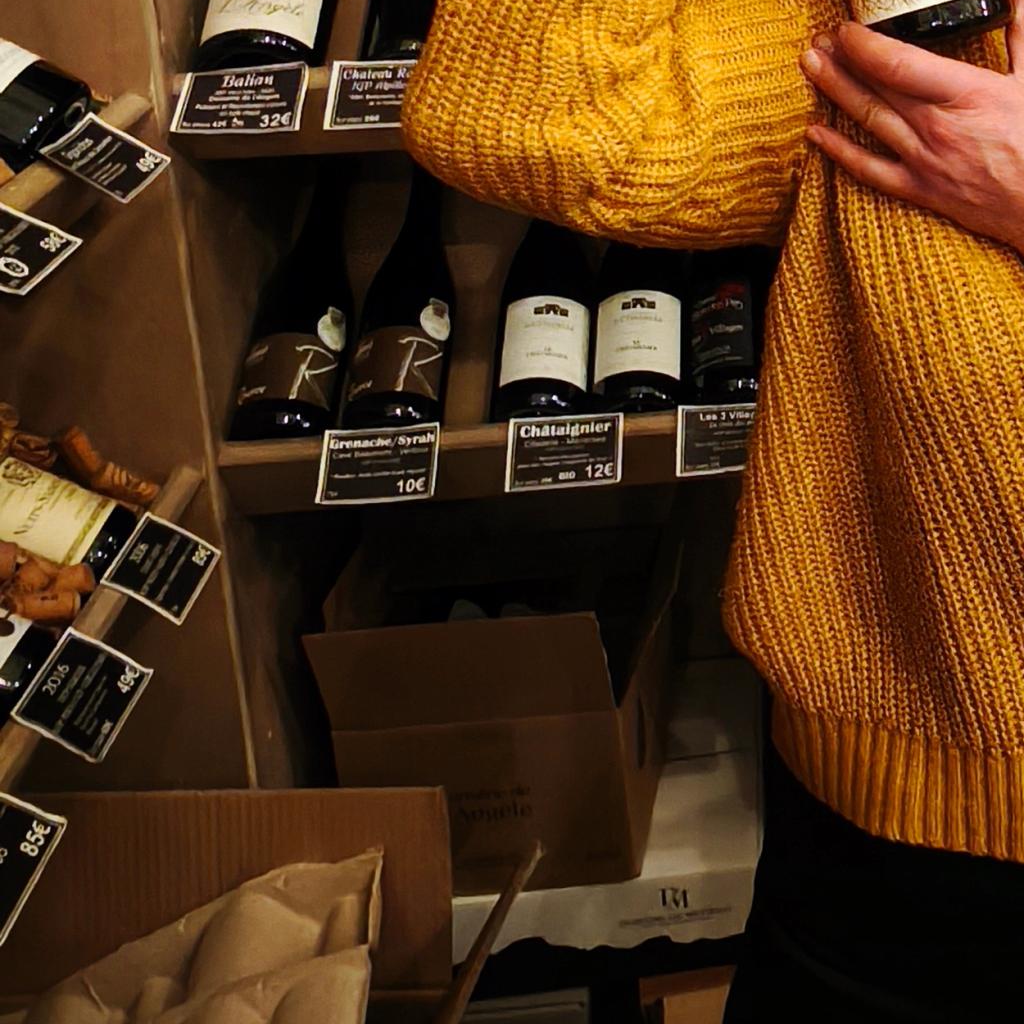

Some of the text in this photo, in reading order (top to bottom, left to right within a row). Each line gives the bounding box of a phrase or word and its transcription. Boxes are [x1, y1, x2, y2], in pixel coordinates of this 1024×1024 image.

[258, 112, 293, 128] 32€
[519, 421, 612, 438] Châtaignier
[329, 432, 437, 450] Grenache/Syrah
[584, 462, 614, 479] 12€
[396, 476, 426, 493] 10€
[40, 663, 70, 697] 2016
[19, 819, 51, 857] 85€
